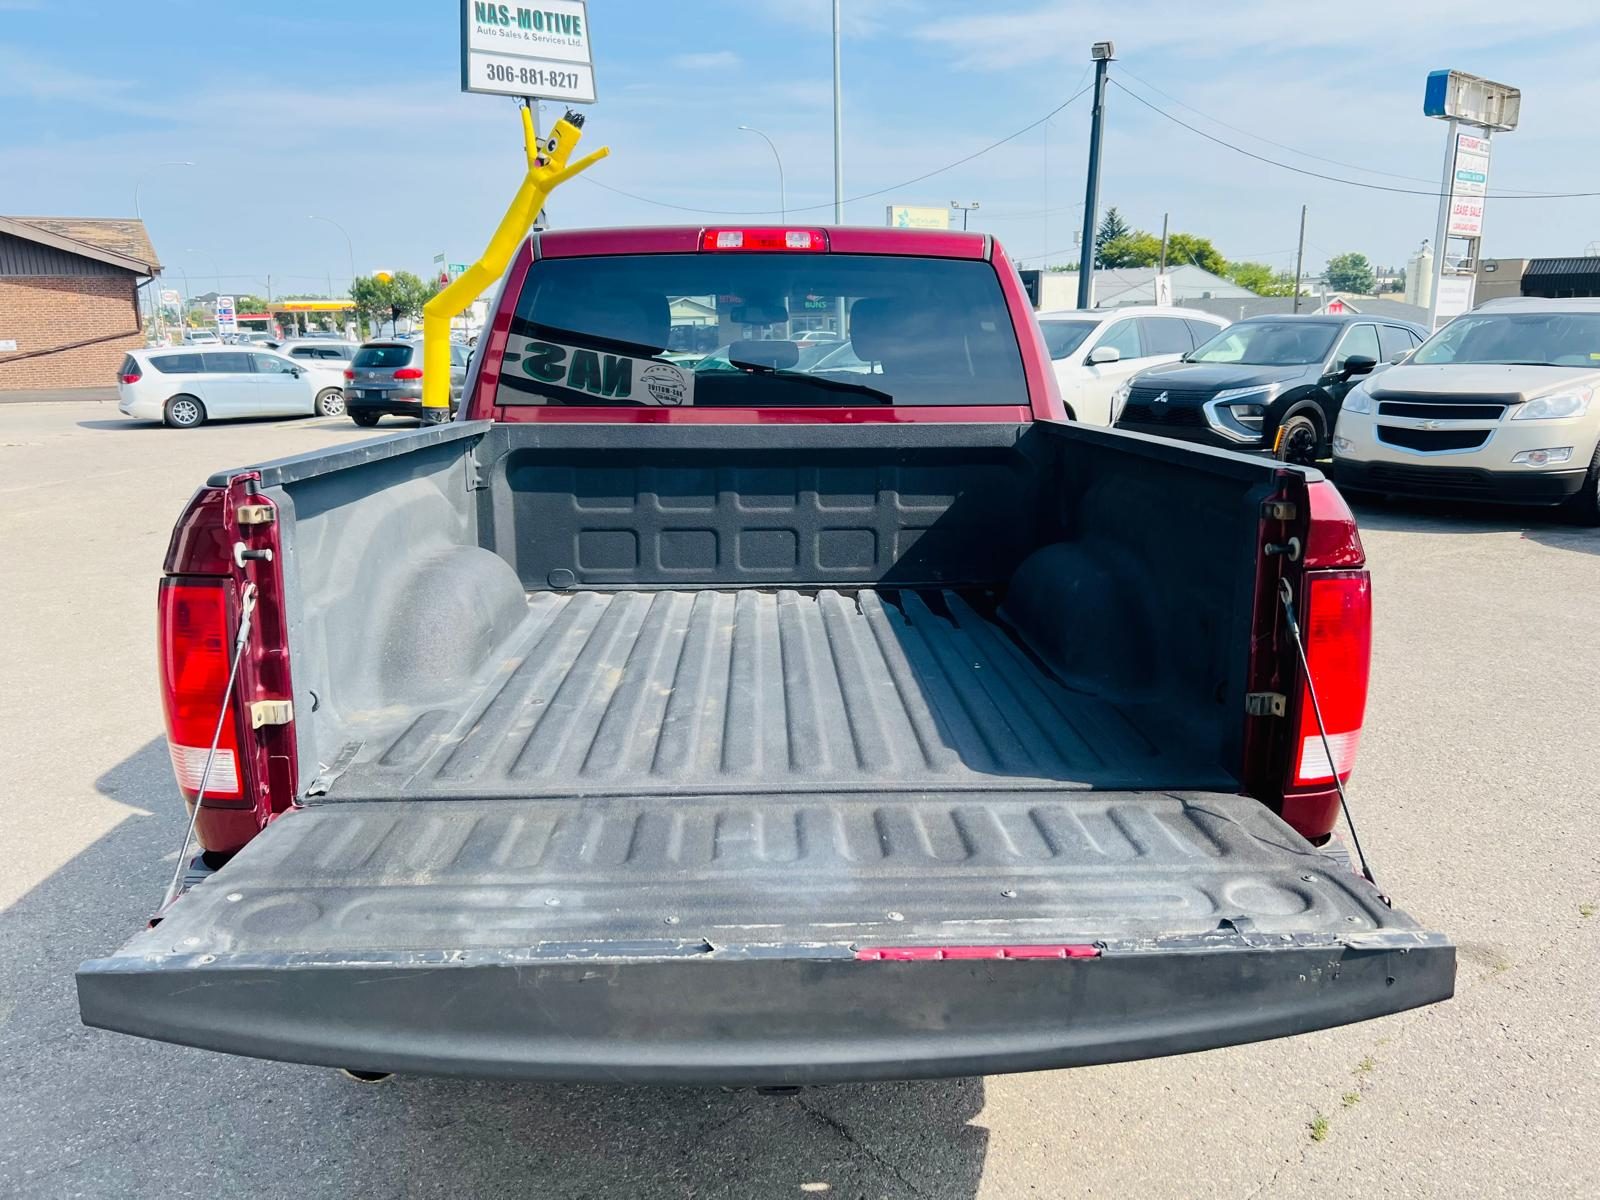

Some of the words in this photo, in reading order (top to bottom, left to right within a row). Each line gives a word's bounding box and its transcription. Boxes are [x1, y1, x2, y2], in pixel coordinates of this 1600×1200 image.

[474, 1, 582, 37] NAS-MOTIVE
[477, 26, 497, 36] Auto
[498, 28, 522, 40] Sales
[523, 32, 531, 41] &
[531, 34, 566, 46] Services
[567, 38, 583, 48] Ltd.
[486, 63, 579, 90] 306-881-8217
[1453, 204, 1469, 217] LEASE
[1469, 206, 1482, 218] SALE
